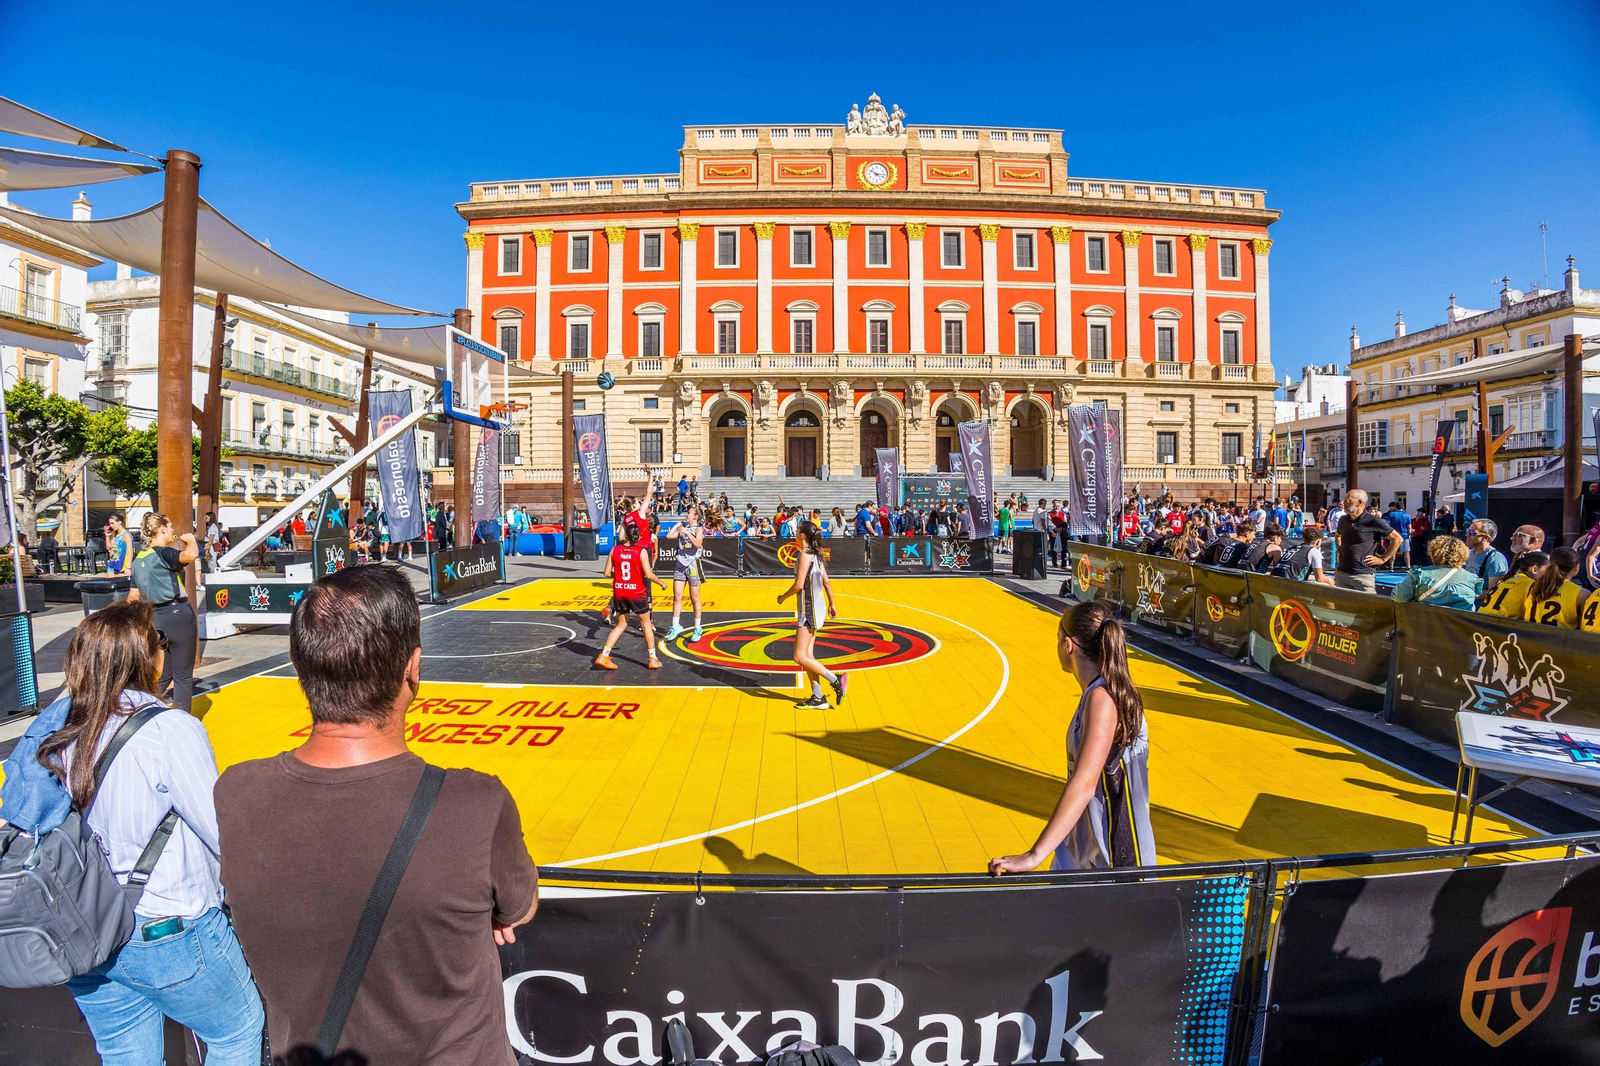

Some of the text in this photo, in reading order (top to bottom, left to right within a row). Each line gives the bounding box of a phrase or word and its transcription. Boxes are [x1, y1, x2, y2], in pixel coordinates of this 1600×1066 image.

[457, 555, 497, 578] CaixaBank
[621, 561, 631, 581] 8
[1529, 600, 1561, 627] 12
[1317, 620, 1360, 641] UNIVERSO
[1317, 632, 1358, 656] MUJER
[1316, 646, 1356, 665] BALONCESTO
[496, 700, 641, 720] MUJER
[502, 970, 1104, 1066] CaixaBank
